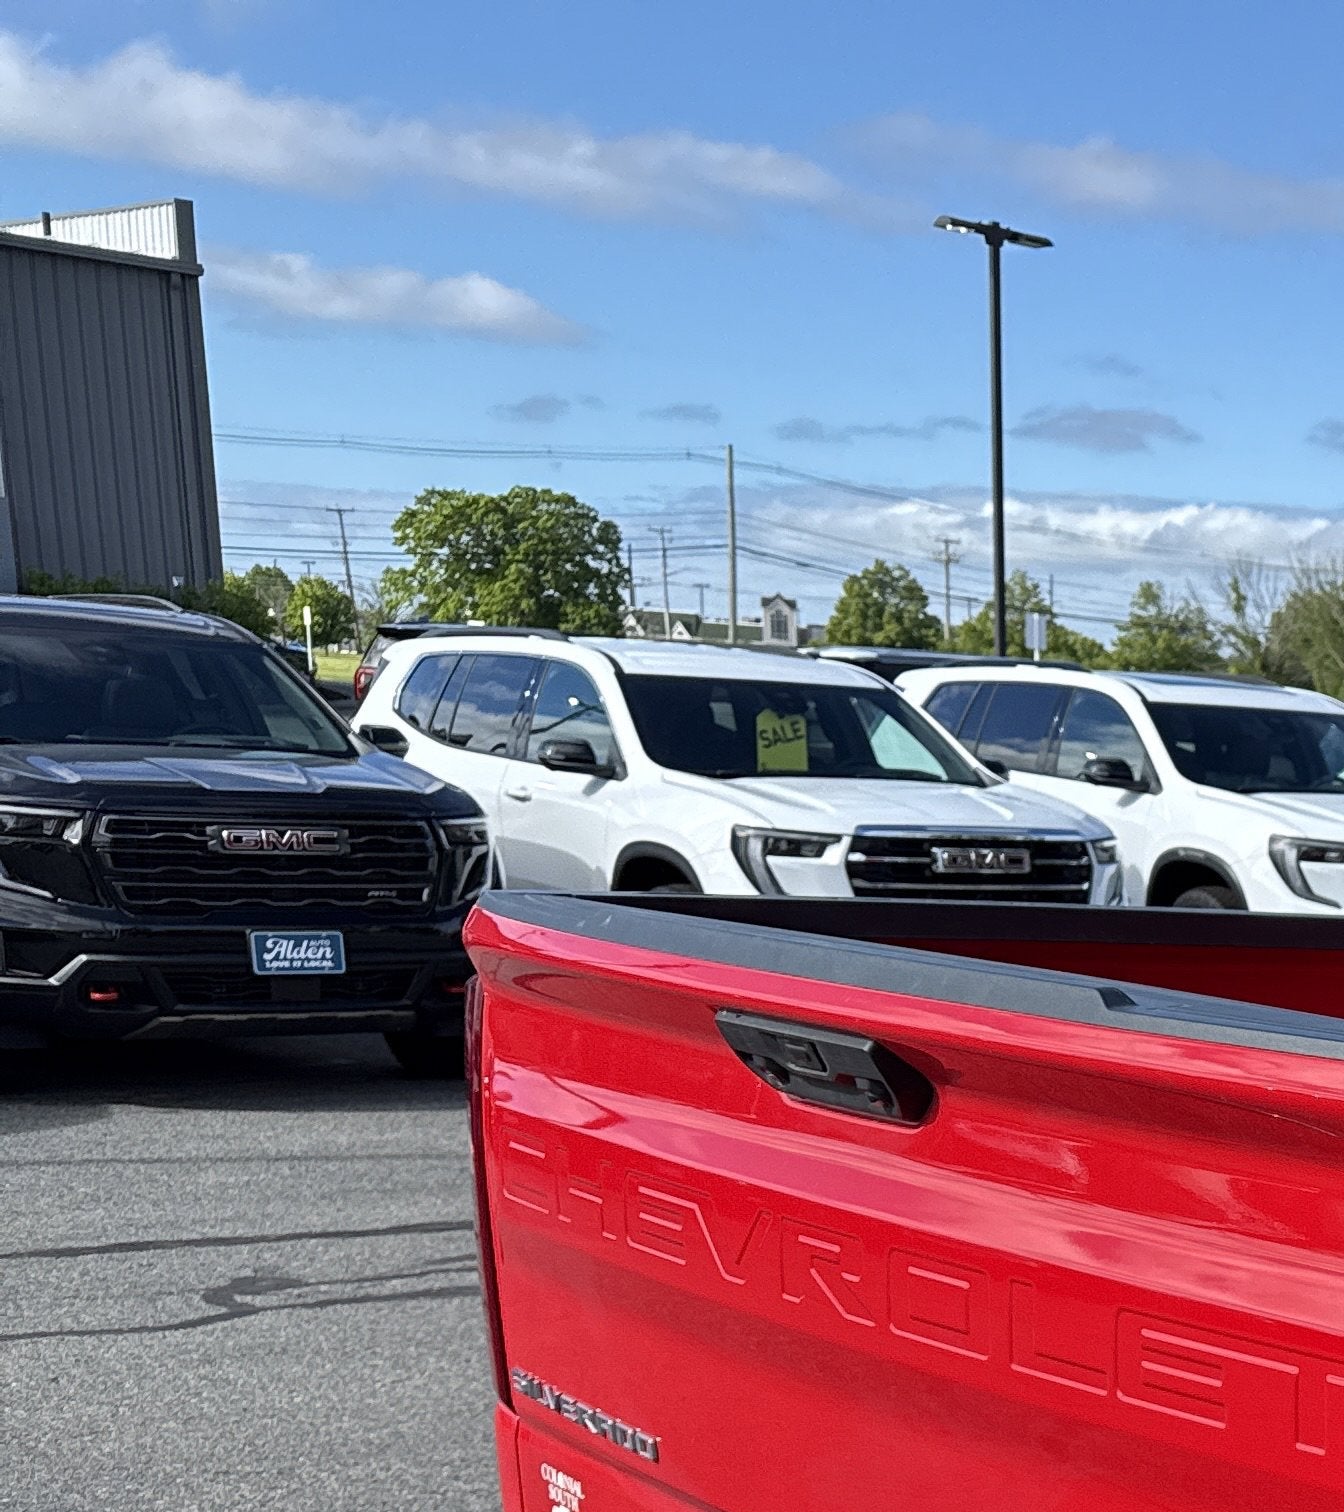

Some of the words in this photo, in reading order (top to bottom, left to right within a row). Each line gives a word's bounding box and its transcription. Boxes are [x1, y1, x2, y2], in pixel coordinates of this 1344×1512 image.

[759, 720, 804, 749] SALE
[221, 829, 340, 851] GMC
[940, 849, 1030, 871] GMC
[262, 937, 335, 960] Alden
[265, 960, 291, 968] LOVE
[303, 960, 335, 968] LOCAL
[511, 1367, 660, 1464] SILVERADO
[548, 1483, 580, 1512] SOUTH
